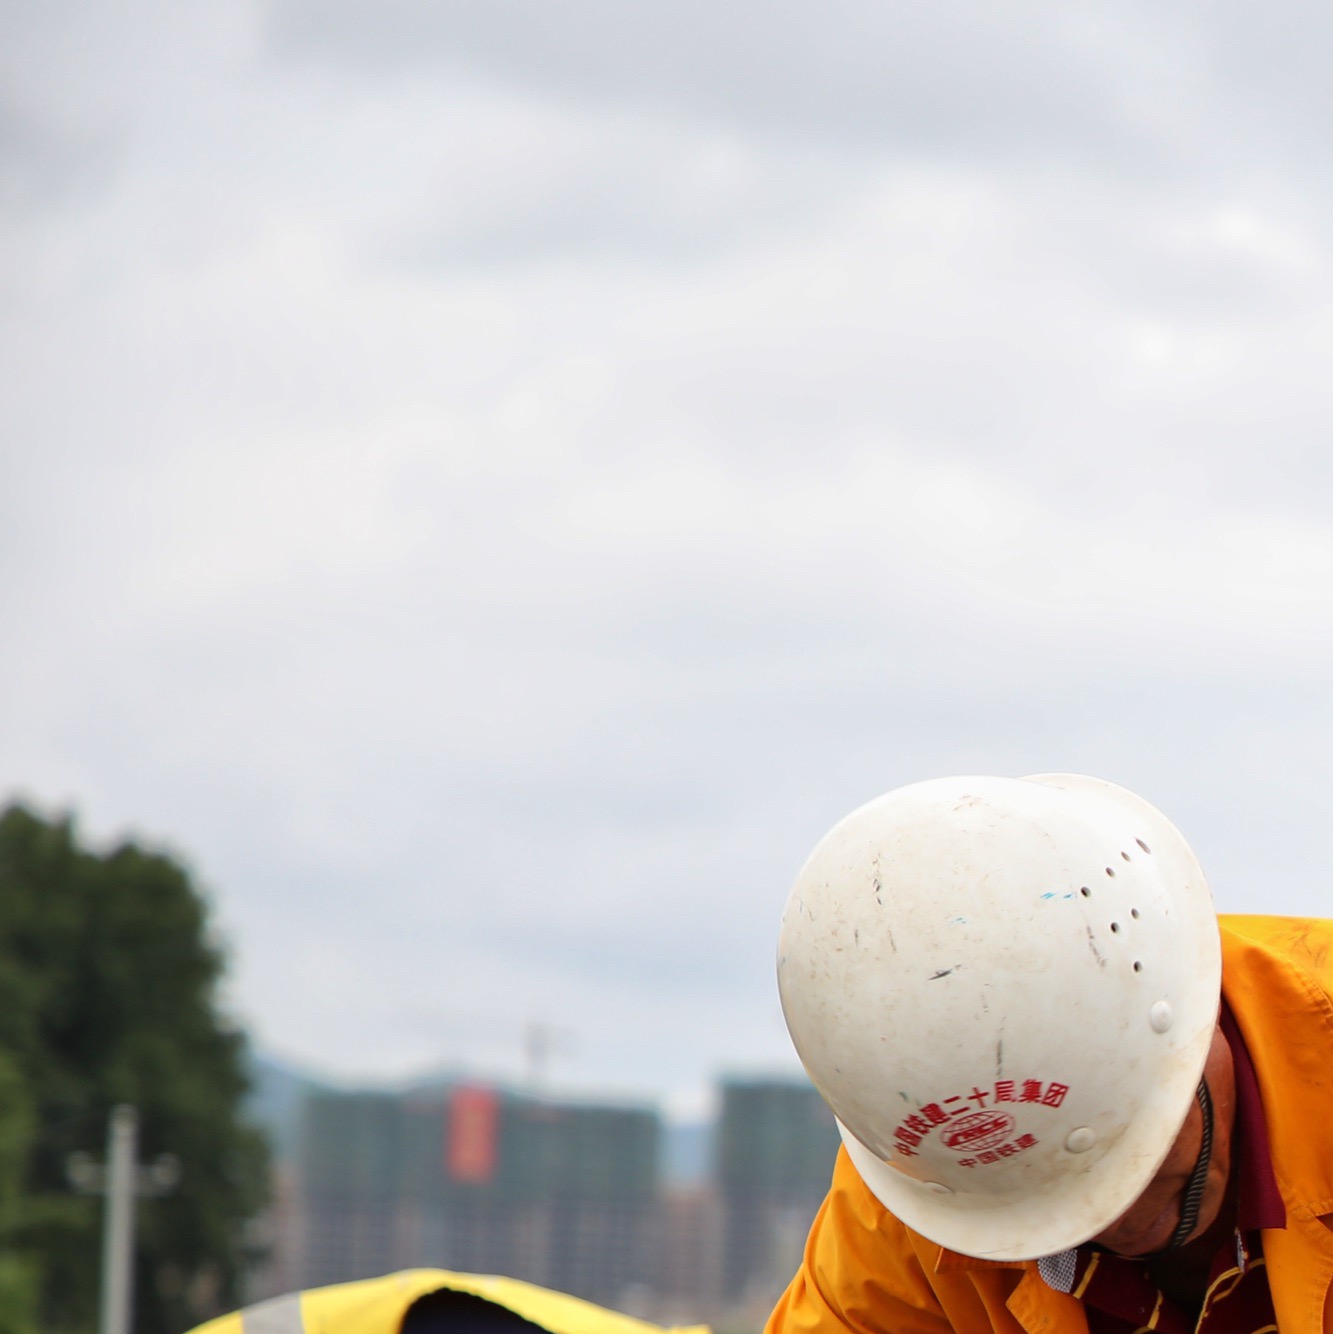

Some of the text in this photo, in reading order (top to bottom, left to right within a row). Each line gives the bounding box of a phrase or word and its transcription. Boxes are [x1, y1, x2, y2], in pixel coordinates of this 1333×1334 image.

[892, 1078, 1070, 1157] 中国铁建二十局集团
[957, 1133, 1040, 1168] 中国铁建
